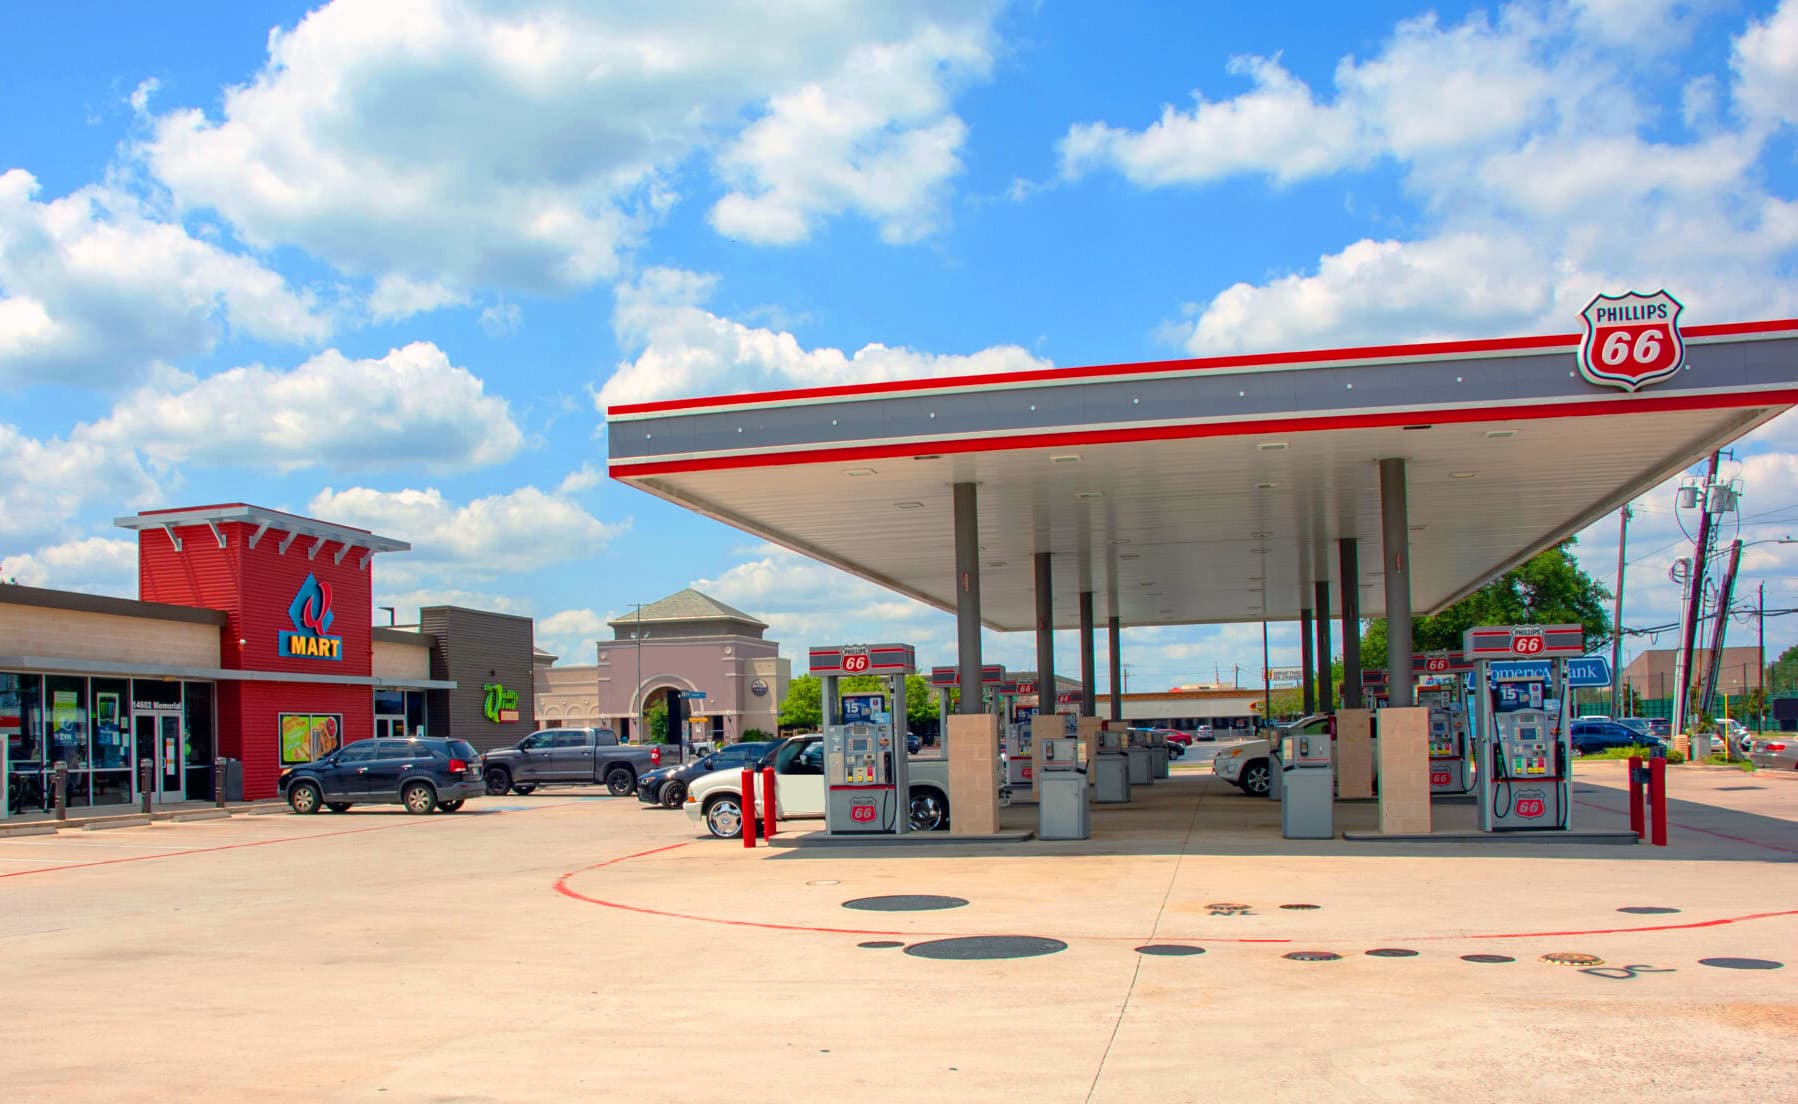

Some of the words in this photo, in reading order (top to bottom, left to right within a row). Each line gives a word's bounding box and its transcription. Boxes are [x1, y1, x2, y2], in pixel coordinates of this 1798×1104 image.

[1597, 304, 1667, 322] PHILLIPS
[1602, 329, 1664, 365] 66
[304, 581, 333, 636] Q
[290, 635, 340, 657] MART
[1516, 638, 1539, 652] 66
[846, 657, 866, 670] 66
[1429, 660, 1445, 671] 66
[1490, 665, 1552, 679] omericA
[1568, 665, 1598, 679] ank
[1020, 684, 1031, 693] 66
[1500, 688, 1517, 700] 15
[846, 703, 859, 714] 15
[1433, 773, 1448, 783] 66
[855, 807, 871, 818] 66
[1520, 802, 1539, 813] 66
